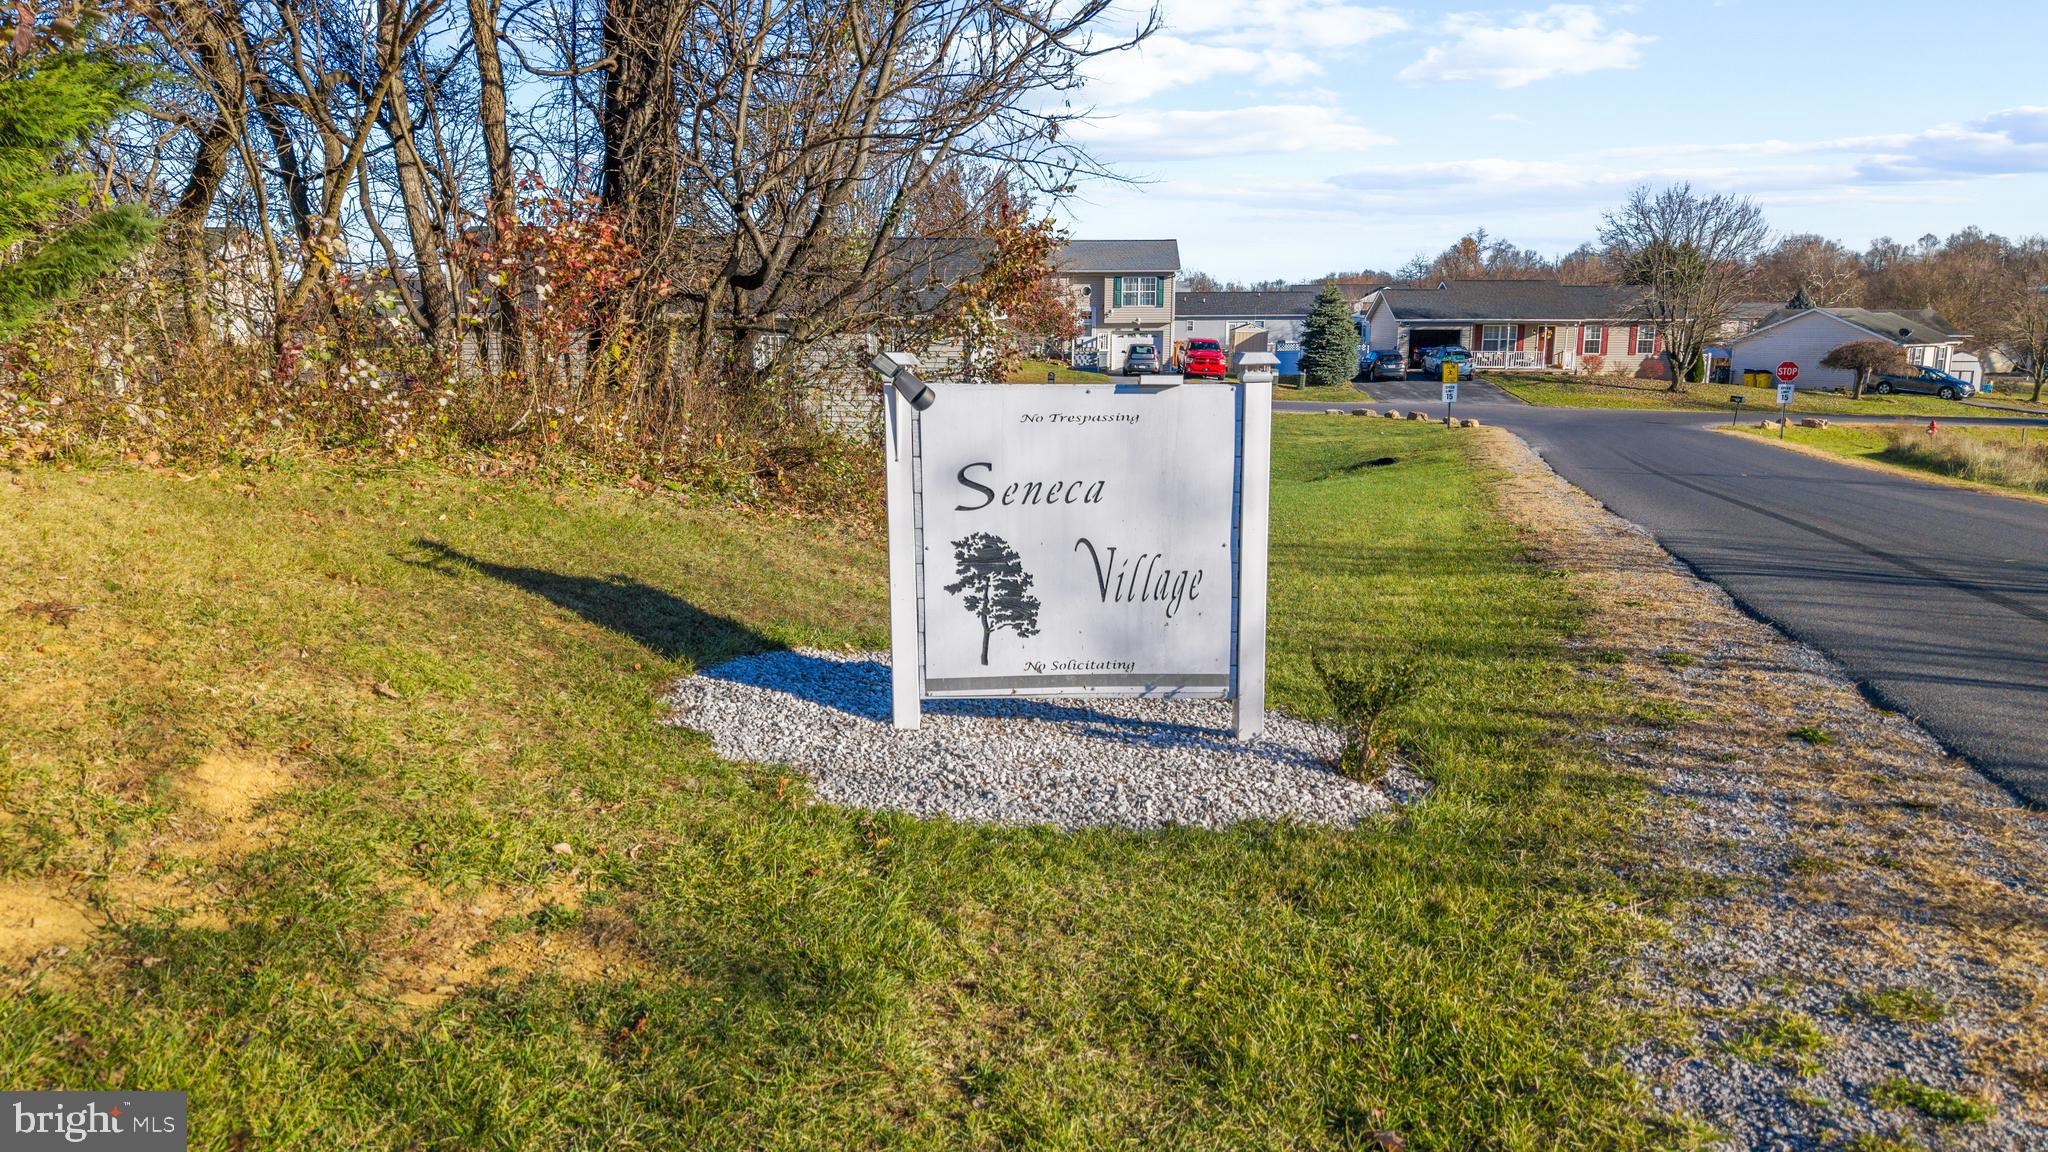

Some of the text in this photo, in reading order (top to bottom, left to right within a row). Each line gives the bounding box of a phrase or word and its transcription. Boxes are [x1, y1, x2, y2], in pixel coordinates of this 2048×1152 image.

[1778, 367, 1797, 375] STOP
[1020, 412, 1140, 426] No Trespassing
[954, 462, 1106, 512] Seneca
[1074, 537, 1203, 619] Village
[1024, 660, 1136, 674] No Solicitating
